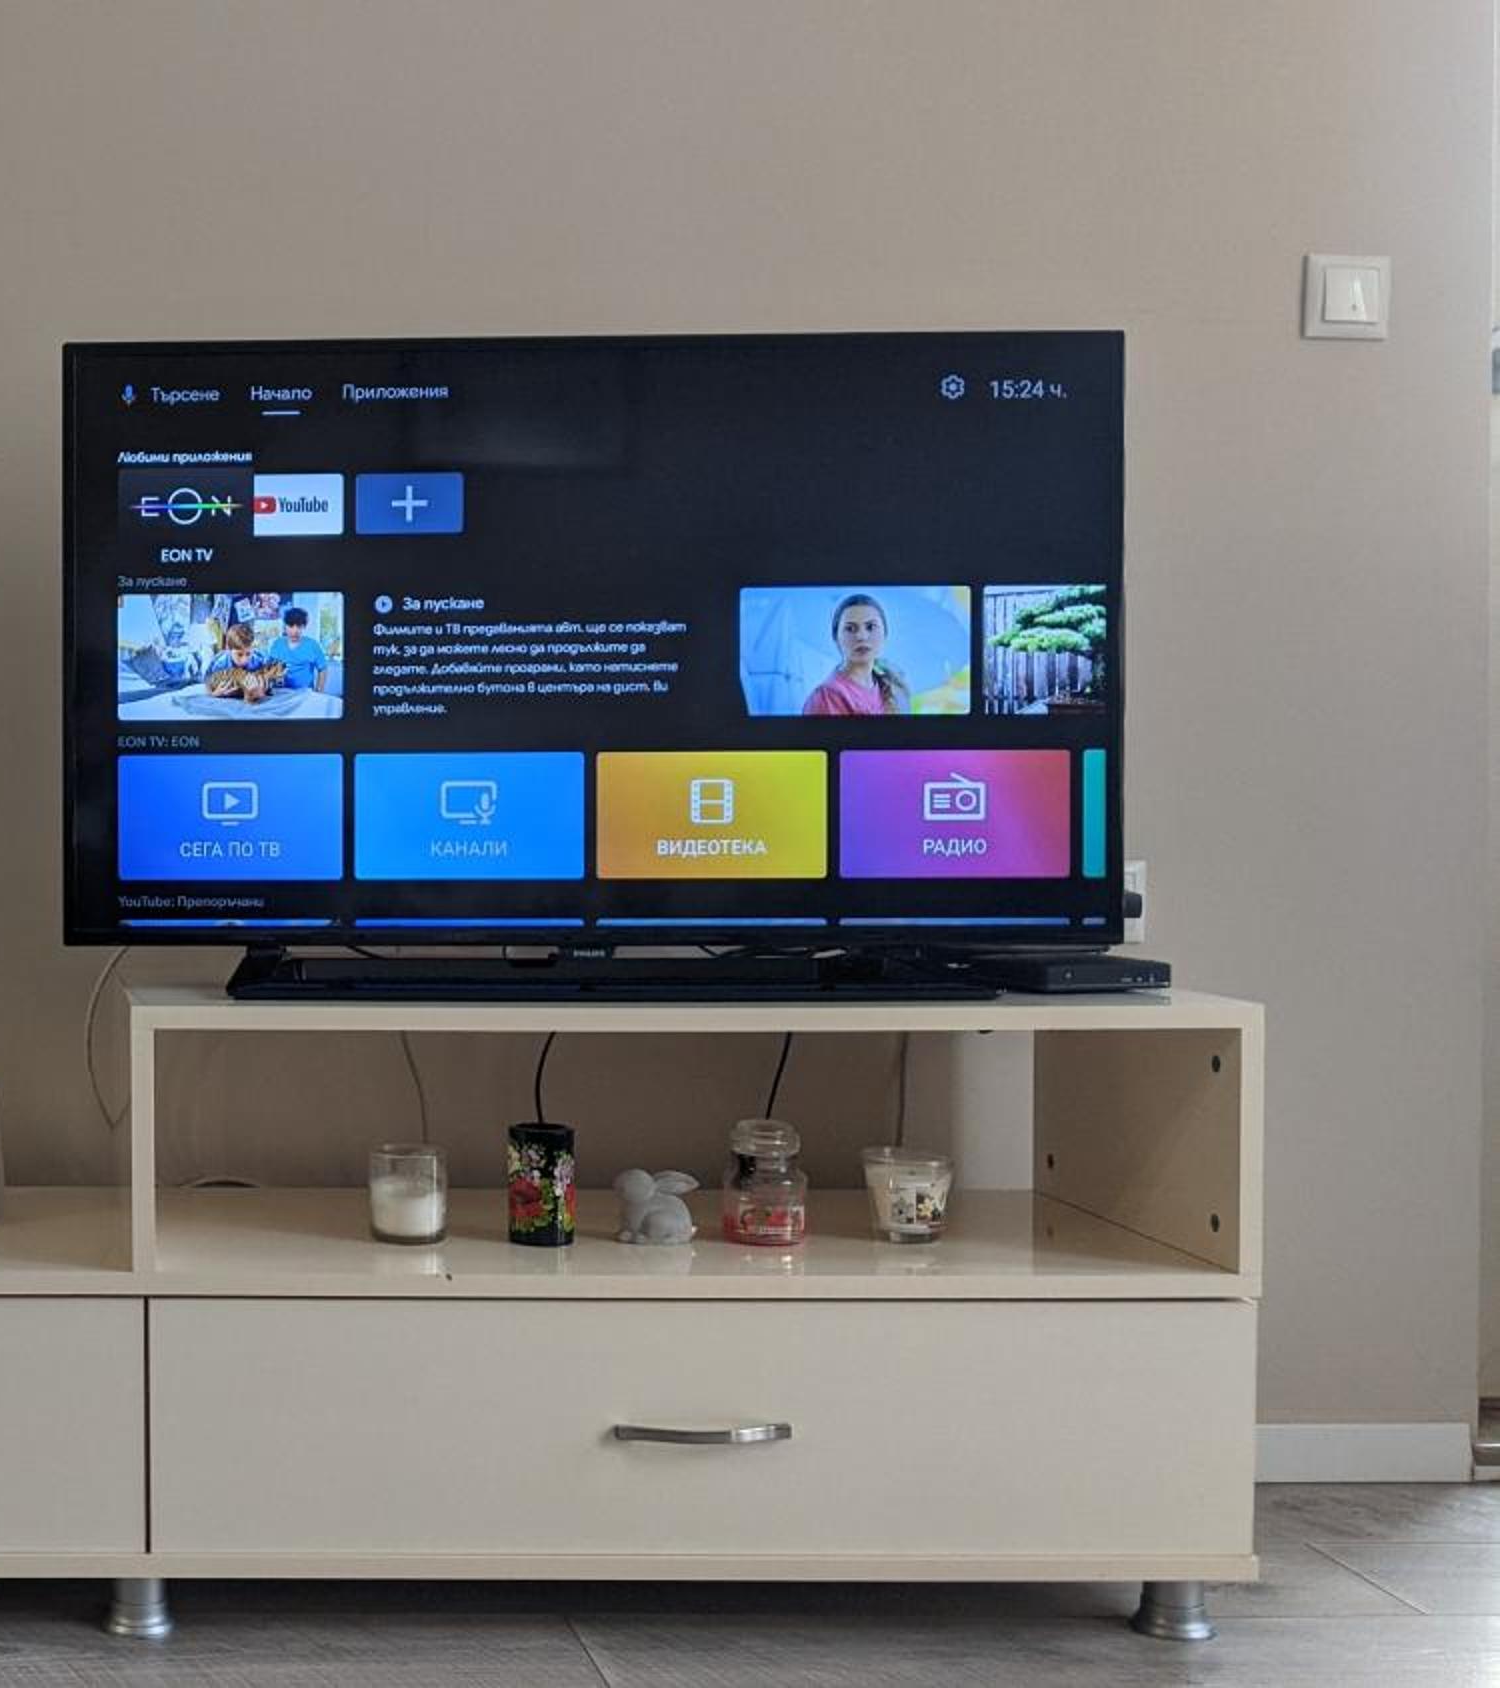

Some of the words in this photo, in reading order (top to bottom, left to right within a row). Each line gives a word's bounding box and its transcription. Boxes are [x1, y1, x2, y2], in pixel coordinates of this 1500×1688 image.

[151, 386, 220, 405] Търсене
[250, 385, 314, 401] Начало
[342, 383, 450, 403] Приложения
[989, 379, 1044, 399] 15:24
[1049, 383, 1067, 399] ч.
[117, 451, 170, 464] Любими
[172, 450, 253, 465] приложения
[140, 487, 233, 525] EON
[278, 495, 329, 513] YouTube
[160, 548, 192, 563] EON
[195, 548, 213, 562] TV
[117, 576, 134, 587] За
[135, 576, 188, 589] пускане
[402, 597, 421, 611] За
[423, 597, 485, 613] пускане
[373, 623, 432, 636] Филмите
[435, 625, 443, 635] и
[445, 623, 461, 635] ТВ
[608, 624, 624, 633] се
[626, 620, 687, 635] показват
[403, 644, 417, 656] за
[419, 645, 435, 656] да
[530, 644, 545, 656] да
[630, 644, 646, 655] да
[569, 661, 602, 673] като
[477, 681, 525, 696] бутона
[596, 683, 611, 693] на
[117, 736, 147, 748] EON
[150, 736, 169, 748] TV:
[171, 736, 200, 748] EON
[179, 841, 223, 858] СЕГА
[228, 841, 253, 858] ПО
[259, 841, 281, 858] ТВ
[431, 839, 508, 857] КАНАЛИ
[657, 838, 769, 859] ВИДЕОТЕКА
[923, 838, 987, 858] РАДИО
